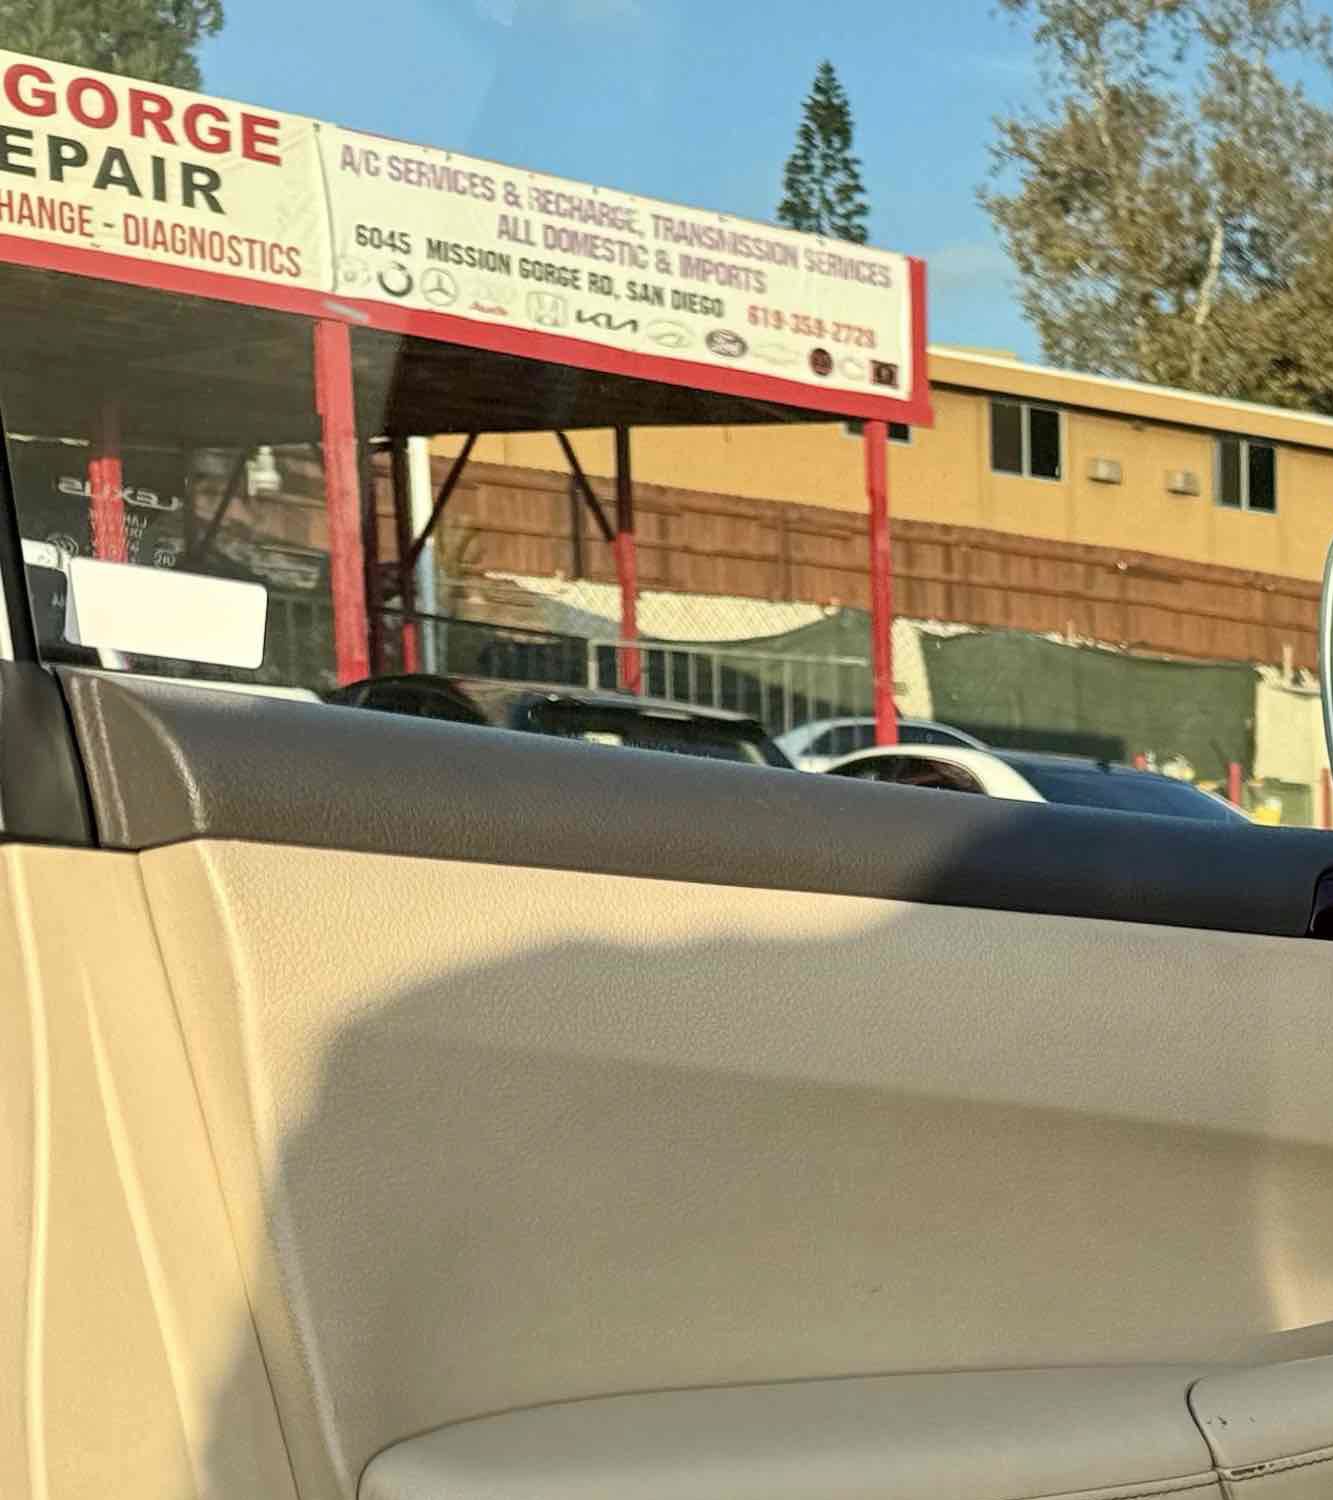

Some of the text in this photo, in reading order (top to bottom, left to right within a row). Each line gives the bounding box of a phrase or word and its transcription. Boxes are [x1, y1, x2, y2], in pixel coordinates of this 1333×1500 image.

[3, 63, 282, 167] GORGE
[123, 213, 301, 278] DIAGNOSTICS
[340, 144, 380, 177] A/C
[387, 155, 496, 202] SERVICES
[503, 181, 521, 209] &
[651, 213, 799, 270] TRANSMISSION
[803, 248, 892, 288] SERVICES
[497, 214, 767, 294] ALL DOMESTIC & IMPORTS
[355, 223, 412, 255] 6045
[426, 237, 512, 275] MISSION
[518, 257, 582, 290] GORGE
[626, 280, 665, 307] SAN
[671, 288, 724, 318] DIEGO
